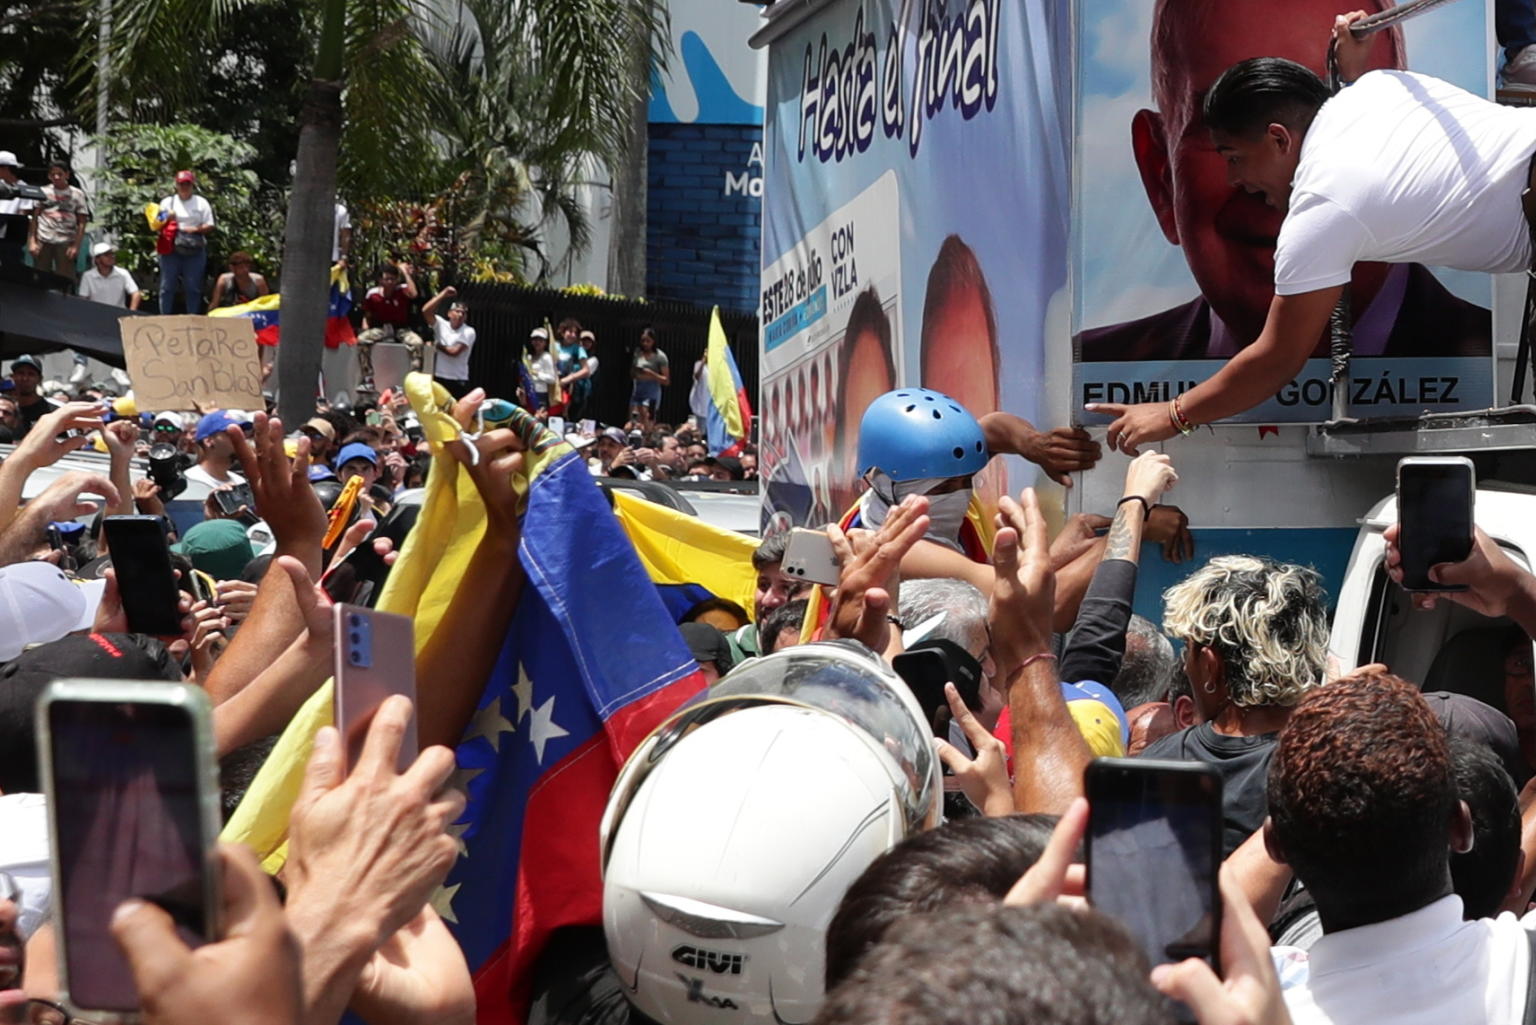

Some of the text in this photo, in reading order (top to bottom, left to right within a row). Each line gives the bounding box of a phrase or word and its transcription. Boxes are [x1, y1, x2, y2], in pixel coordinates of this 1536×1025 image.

[798, 6, 877, 163] Hasta
[831, 221, 854, 264] CON
[763, 278, 783, 326] ESTE
[784, 269, 795, 310] 28
[831, 257, 857, 300] VZLA
[143, 359, 209, 400] San
[672, 945, 742, 974] GIVI
